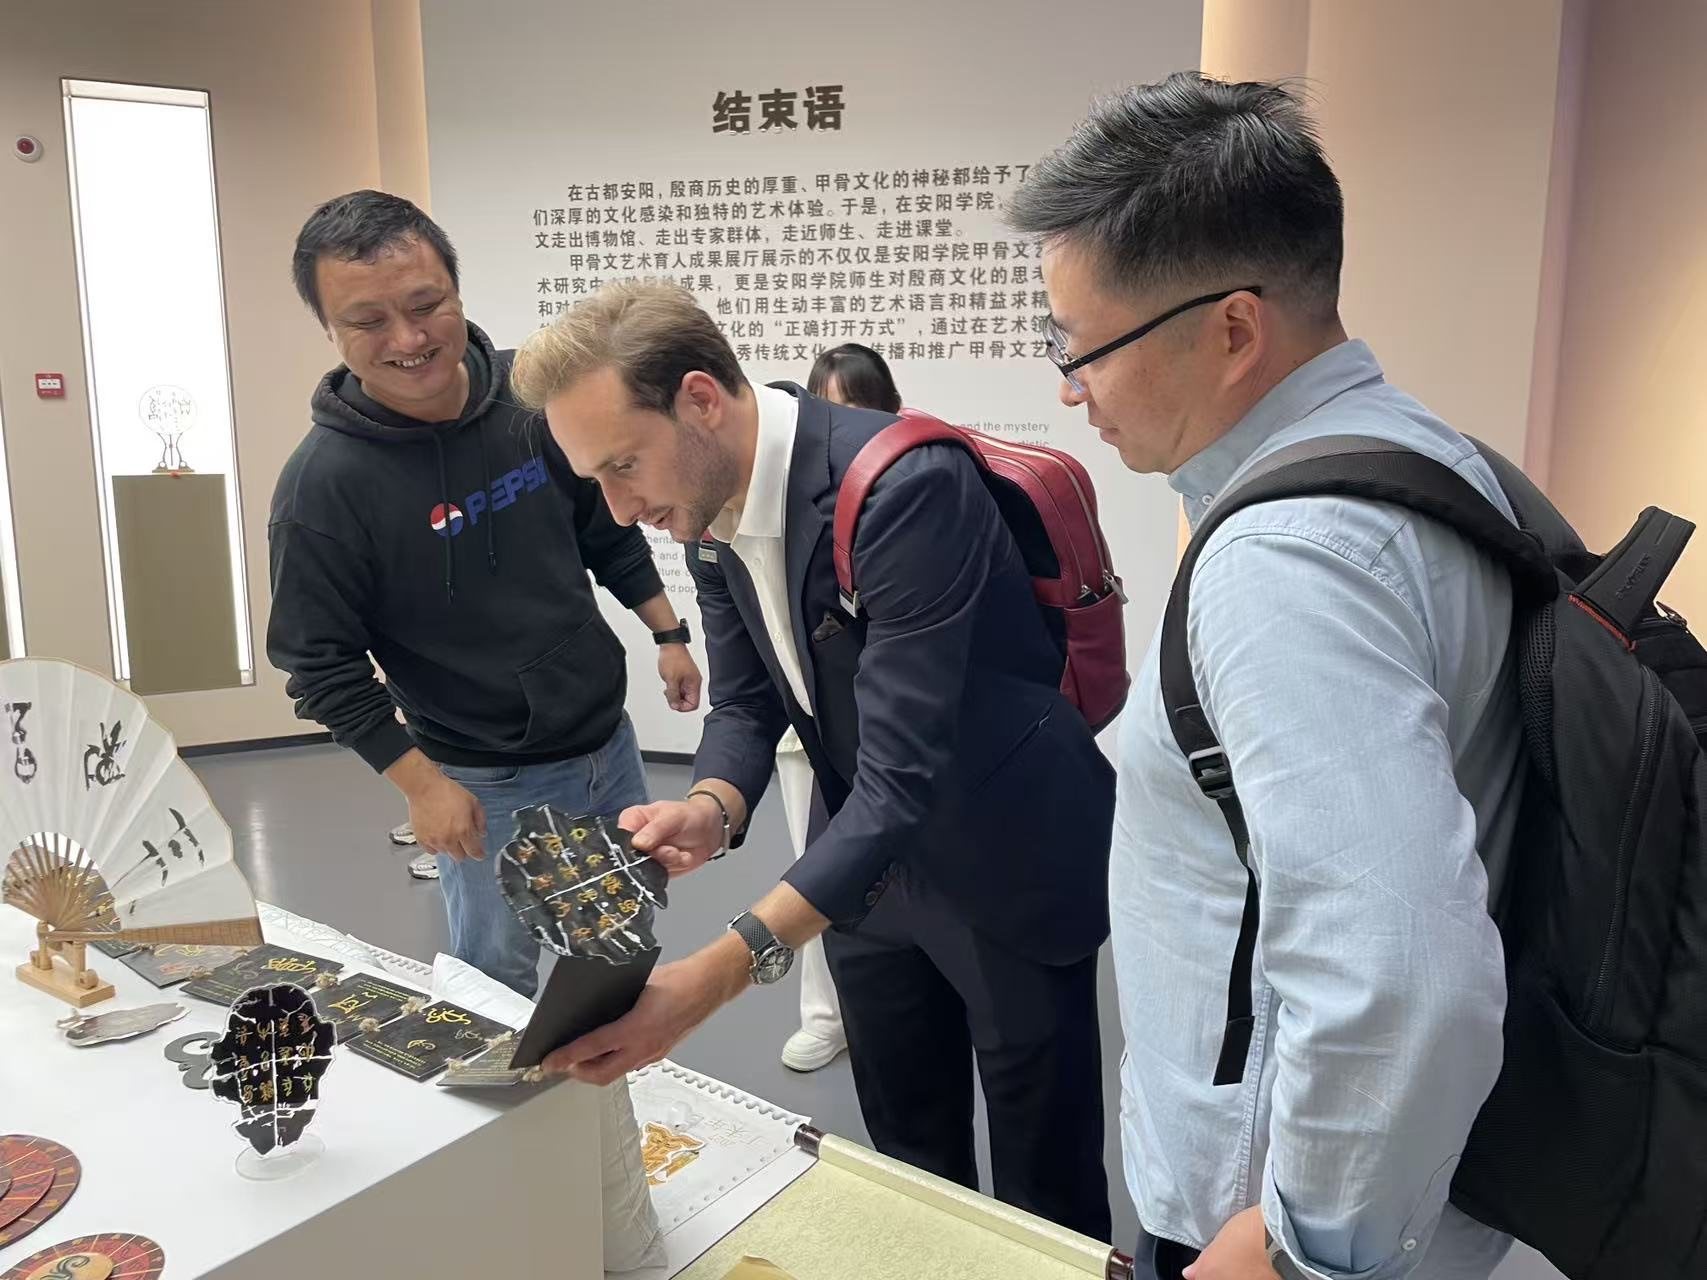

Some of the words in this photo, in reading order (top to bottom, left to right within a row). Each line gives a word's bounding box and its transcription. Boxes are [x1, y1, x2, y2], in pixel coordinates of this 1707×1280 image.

[712, 85, 845, 134] 结束语
[983, 422, 1001, 432] the
[1003, 422, 1049, 434] mystery
[465, 455, 548, 526] PEPSI
[660, 552, 678, 560] and
